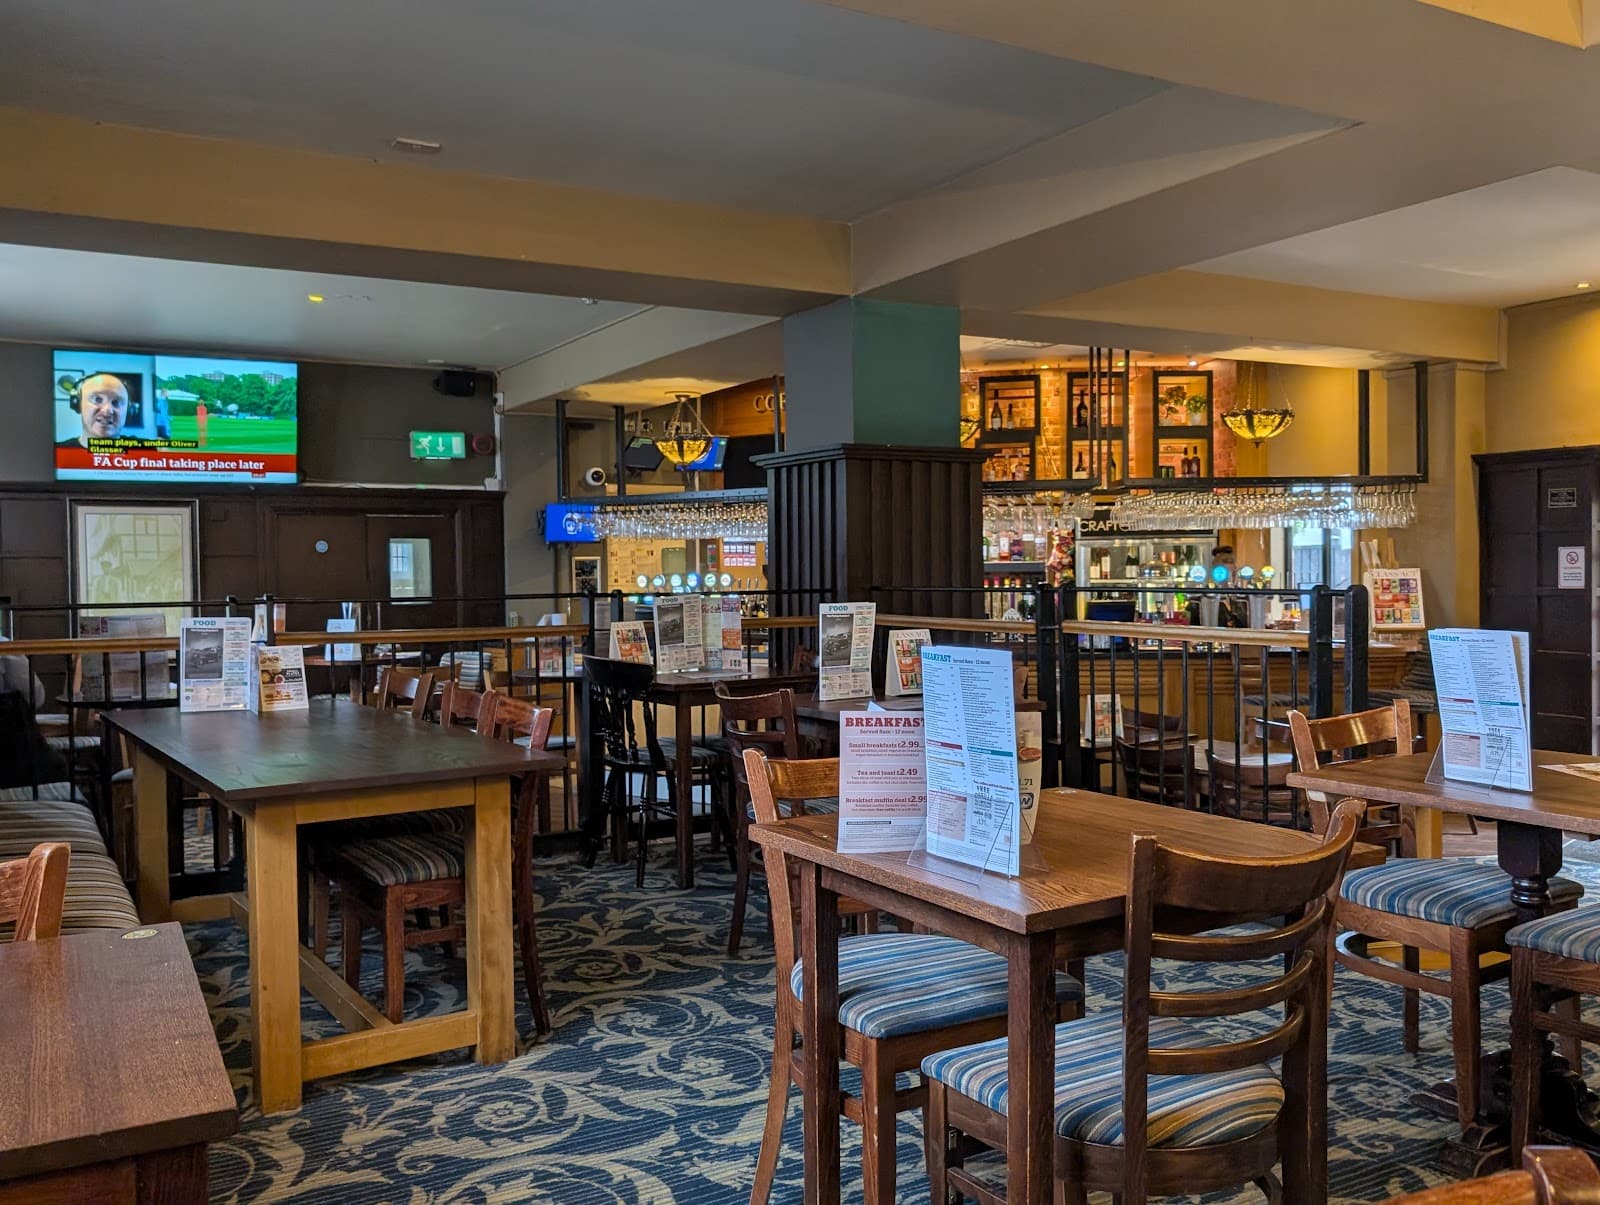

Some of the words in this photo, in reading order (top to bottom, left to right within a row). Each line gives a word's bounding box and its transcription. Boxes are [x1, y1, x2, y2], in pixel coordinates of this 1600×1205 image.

[90, 438, 113, 446] team
[144, 439, 169, 447] under
[171, 440, 197, 448] Oliver
[93, 456, 111, 467] FA
[114, 457, 138, 470] Cup
[140, 457, 167, 468] final
[170, 458, 206, 471] taking
[207, 459, 237, 471] place
[239, 459, 265, 470] later
[897, 740, 920, 749] £2.99
[896, 768, 918, 776] £2.49
